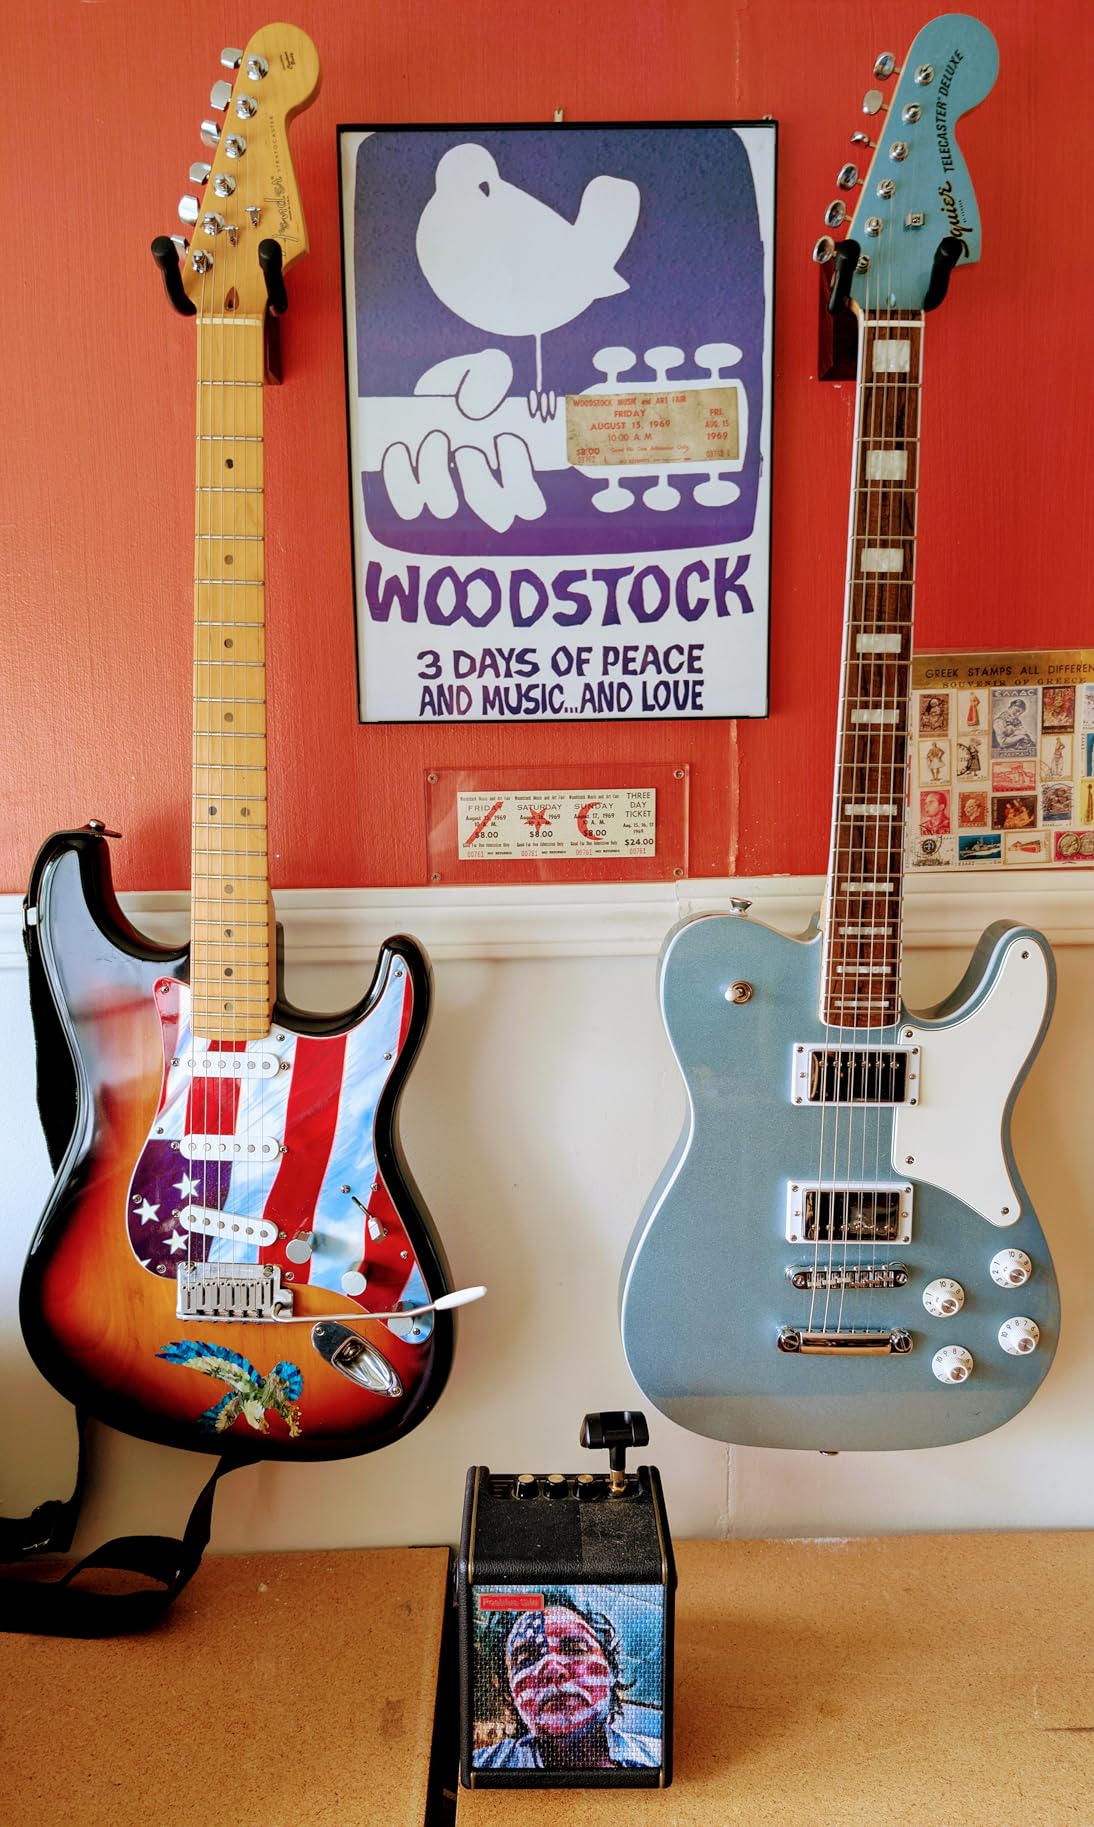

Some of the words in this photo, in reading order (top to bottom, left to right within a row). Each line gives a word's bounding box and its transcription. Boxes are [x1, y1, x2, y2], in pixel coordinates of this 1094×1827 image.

[938, 49, 964, 97] DELUXE
[614, 408, 646, 417] FRIDAY
[591, 422, 625, 431] AUGUST
[650, 419, 671, 428] 1969
[707, 431, 728, 440] 1969
[365, 554, 754, 628] WOODSTOCK
[417, 650, 442, 679] 3
[453, 647, 540, 679] DAYS
[551, 646, 593, 677] OF
[602, 644, 705, 676] PEACE
[925, 668, 959, 679] GREEK
[968, 665, 1012, 678] STAMPS
[1020, 664, 1039, 675] ALL
[942, 680, 1007, 688] SOUVENIR
[1037, 677, 1087, 685] GREECE
[419, 683, 472, 717] AND
[641, 680, 705, 712] LOVE
[630, 801, 647, 809] DAY
[625, 810, 651, 818] TICKET
[475, 831, 499, 839] $8.00
[529, 830, 553, 838] $8.00
[583, 829, 607, 837] $8.00
[625, 838, 654, 846] $24.00
